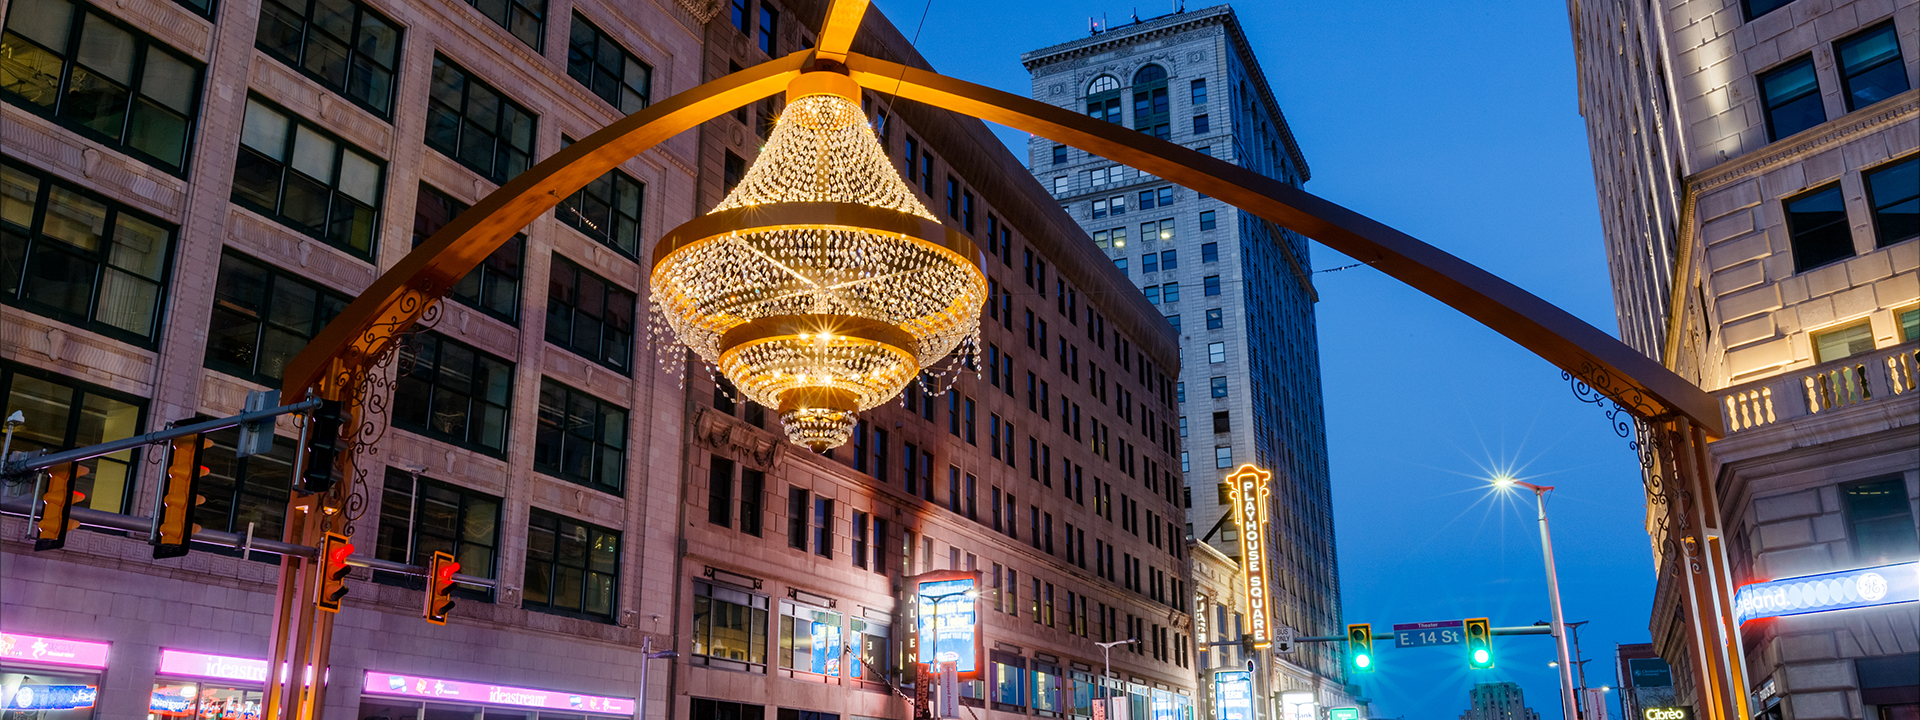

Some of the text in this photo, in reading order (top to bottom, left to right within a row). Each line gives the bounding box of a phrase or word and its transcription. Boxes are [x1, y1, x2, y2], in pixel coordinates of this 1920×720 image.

[1243, 481, 1265, 641] PLAYHOUSE SQUARE
[908, 594, 917, 662] ALLEN
[1400, 630, 1459, 645] E. 14 St
[204, 656, 268, 682] ideastre
[489, 686, 546, 707] ideastream
[1209, 683, 1217, 716] OHIO
[1646, 707, 1684, 720] Cibrèo
